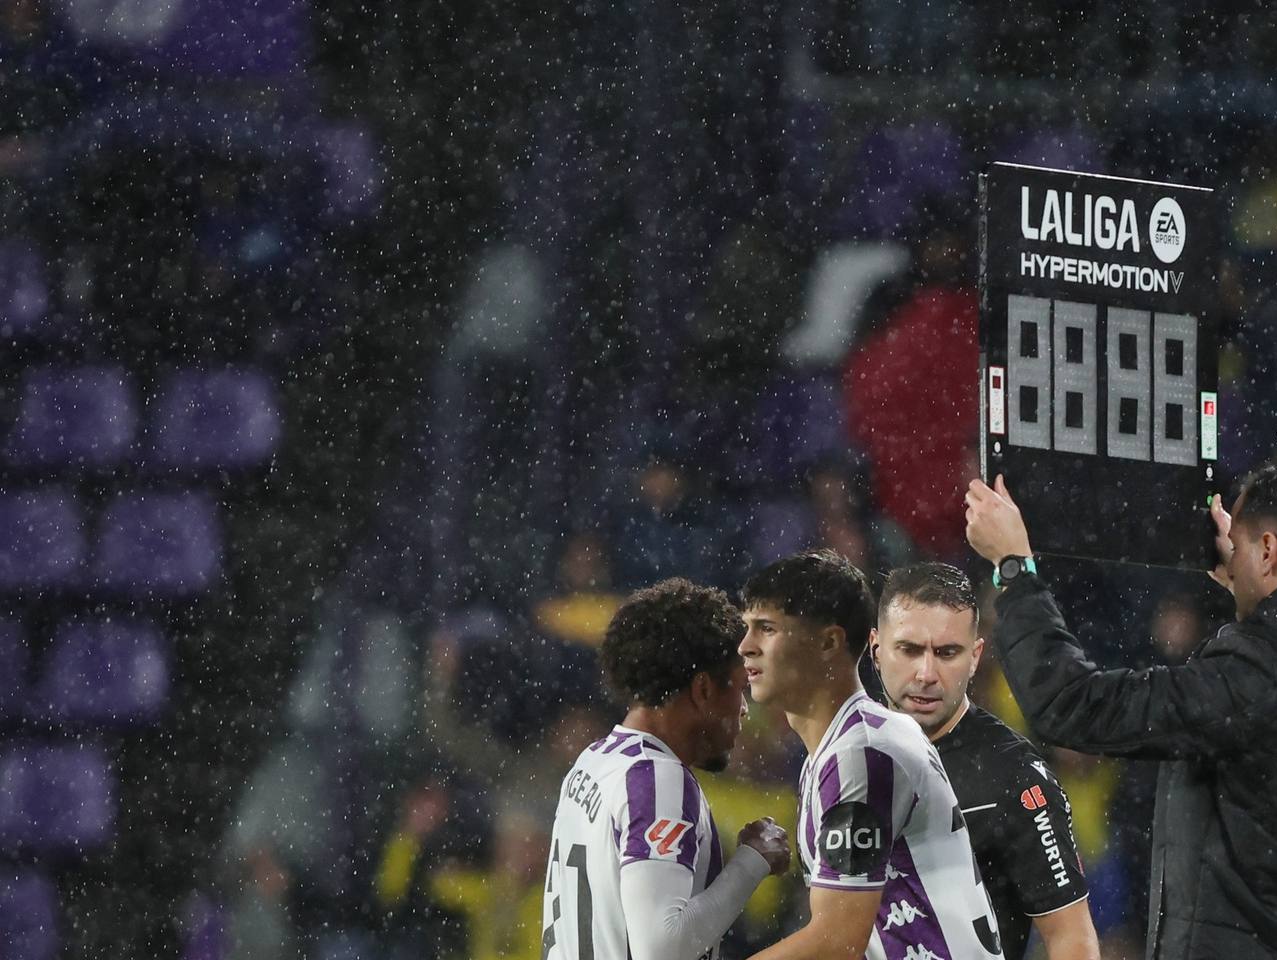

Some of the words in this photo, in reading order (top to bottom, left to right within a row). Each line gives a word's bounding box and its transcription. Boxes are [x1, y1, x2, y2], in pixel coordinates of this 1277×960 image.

[1021, 186, 1141, 253] LALIGA
[1156, 212, 1179, 235] EA
[1155, 233, 1180, 246] SPORTS
[565, 769, 603, 824] CEAU
[826, 827, 881, 850] DIGI
[1033, 809, 1071, 888] WÜRTH
